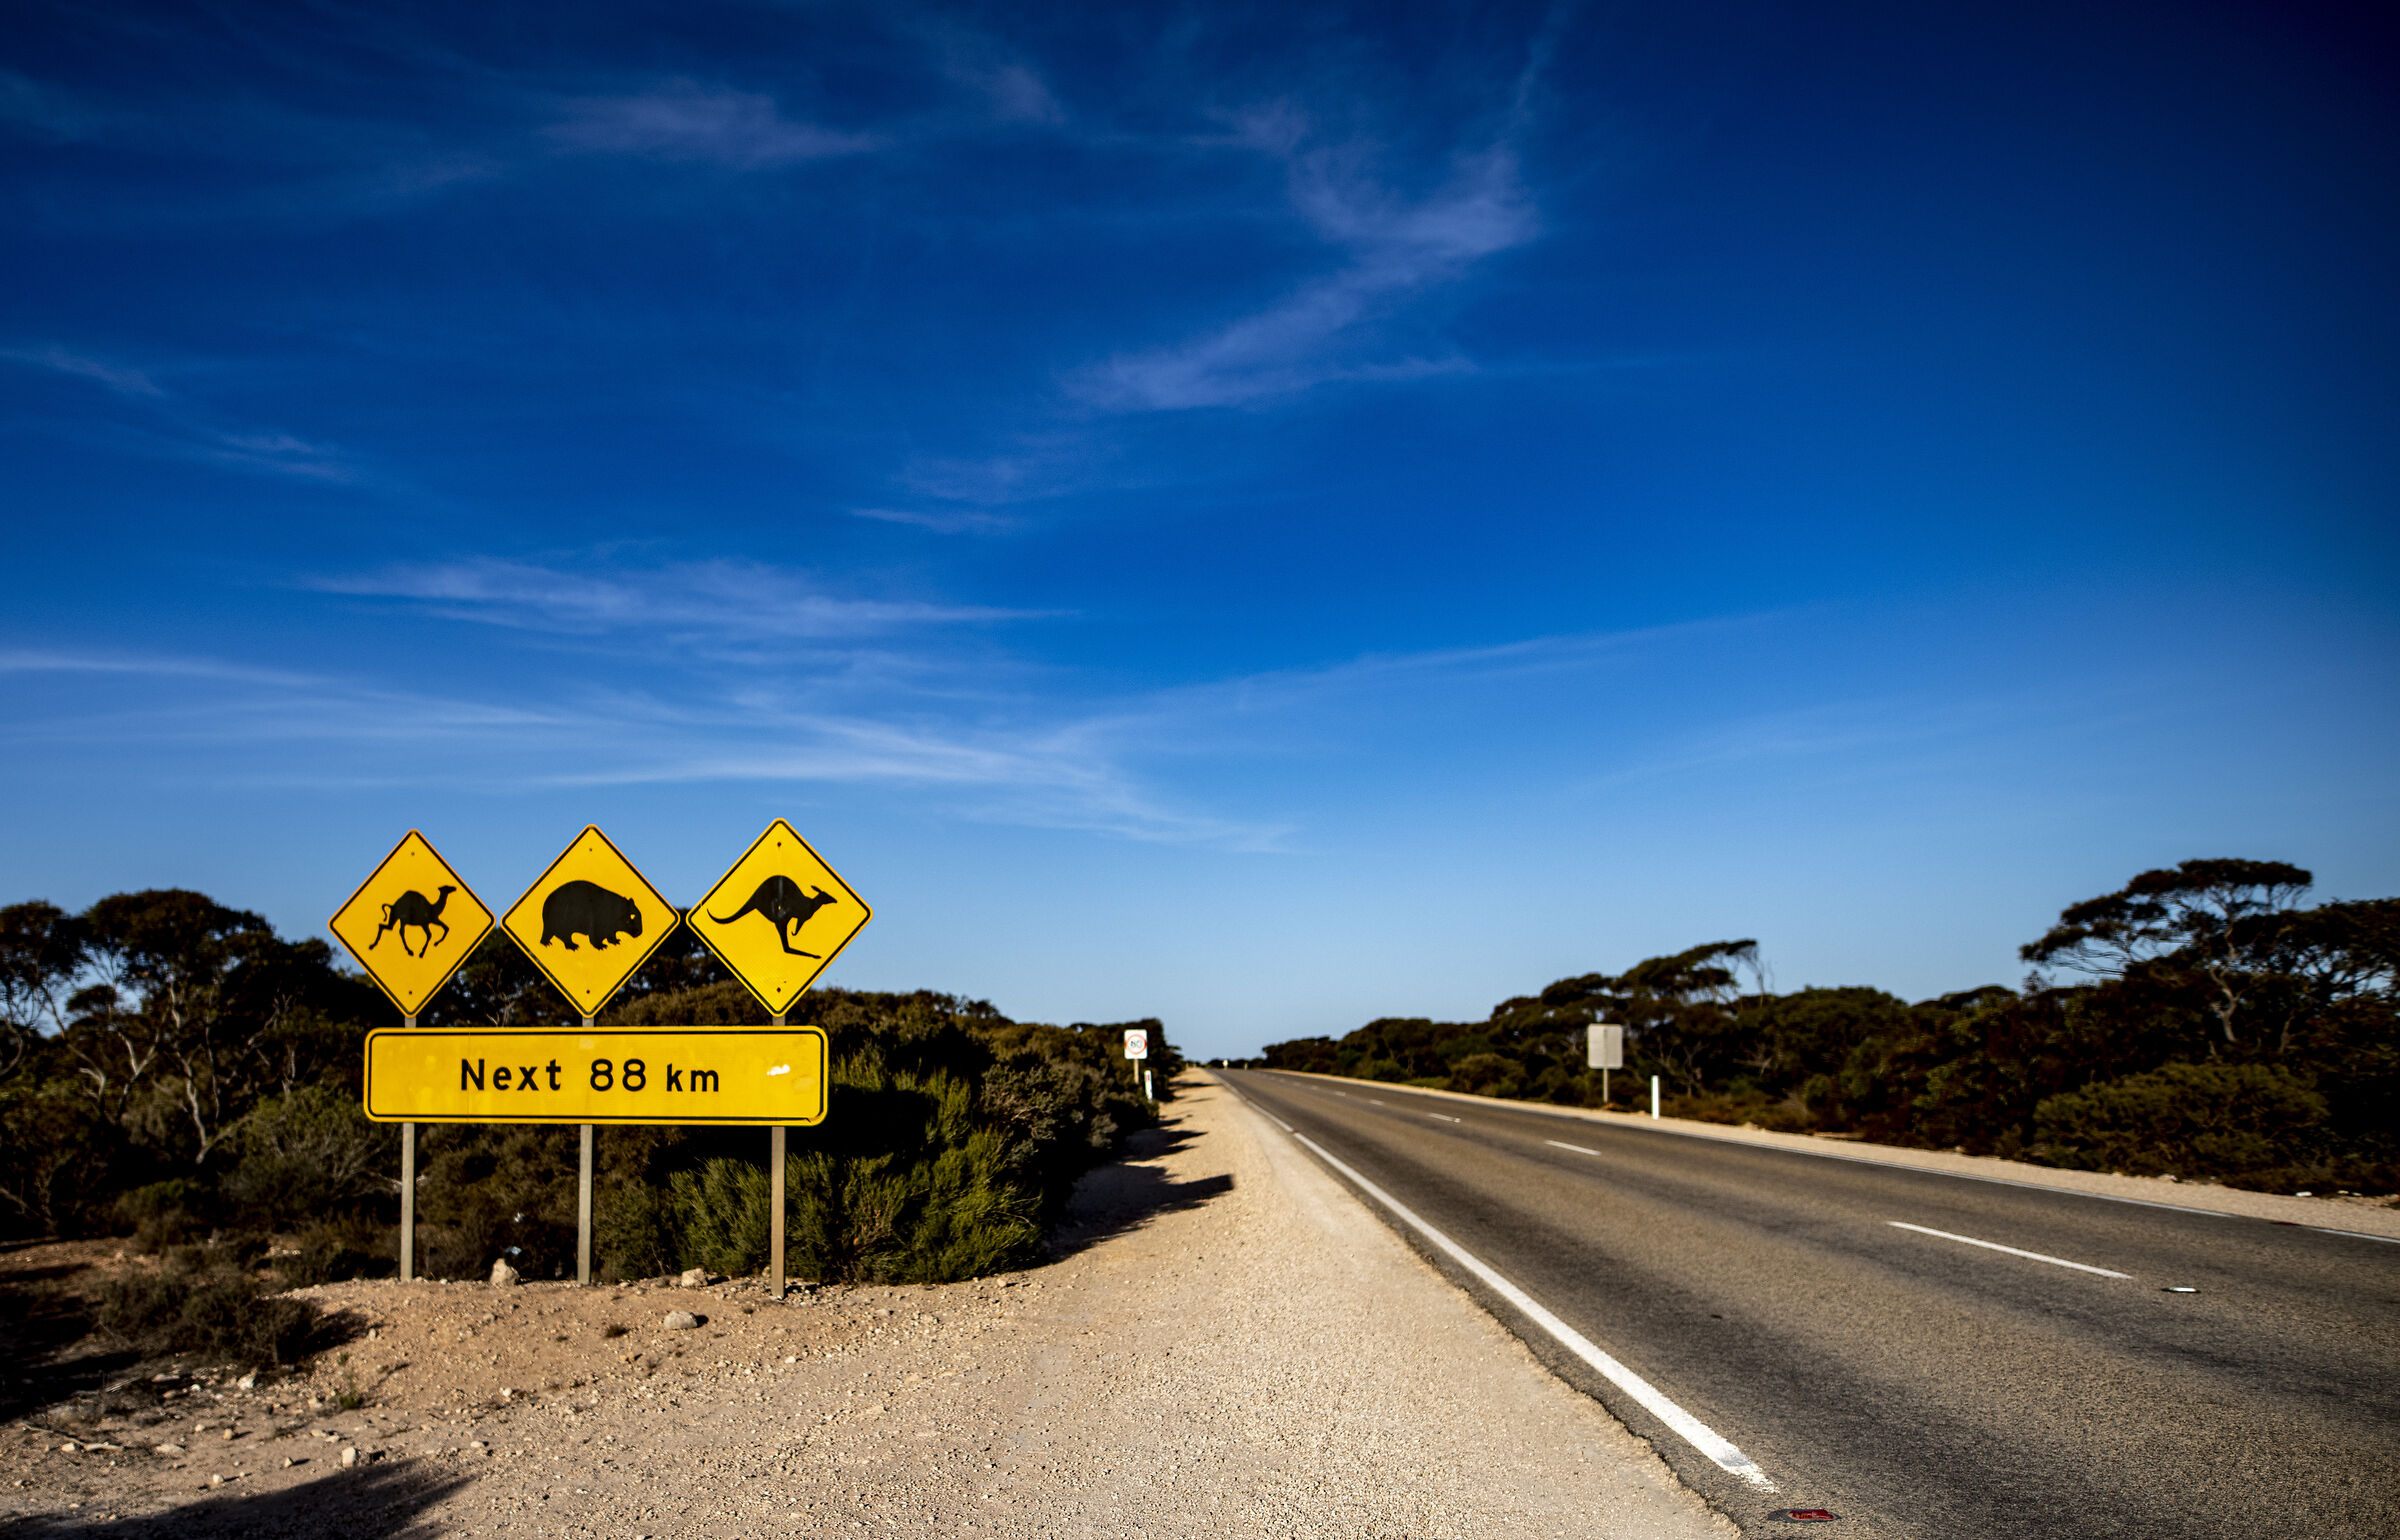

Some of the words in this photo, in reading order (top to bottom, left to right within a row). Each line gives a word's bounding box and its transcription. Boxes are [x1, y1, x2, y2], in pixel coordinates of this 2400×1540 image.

[461, 1058, 562, 1091] Next
[589, 1058, 647, 1092] 88
[666, 1063, 719, 1092] km
